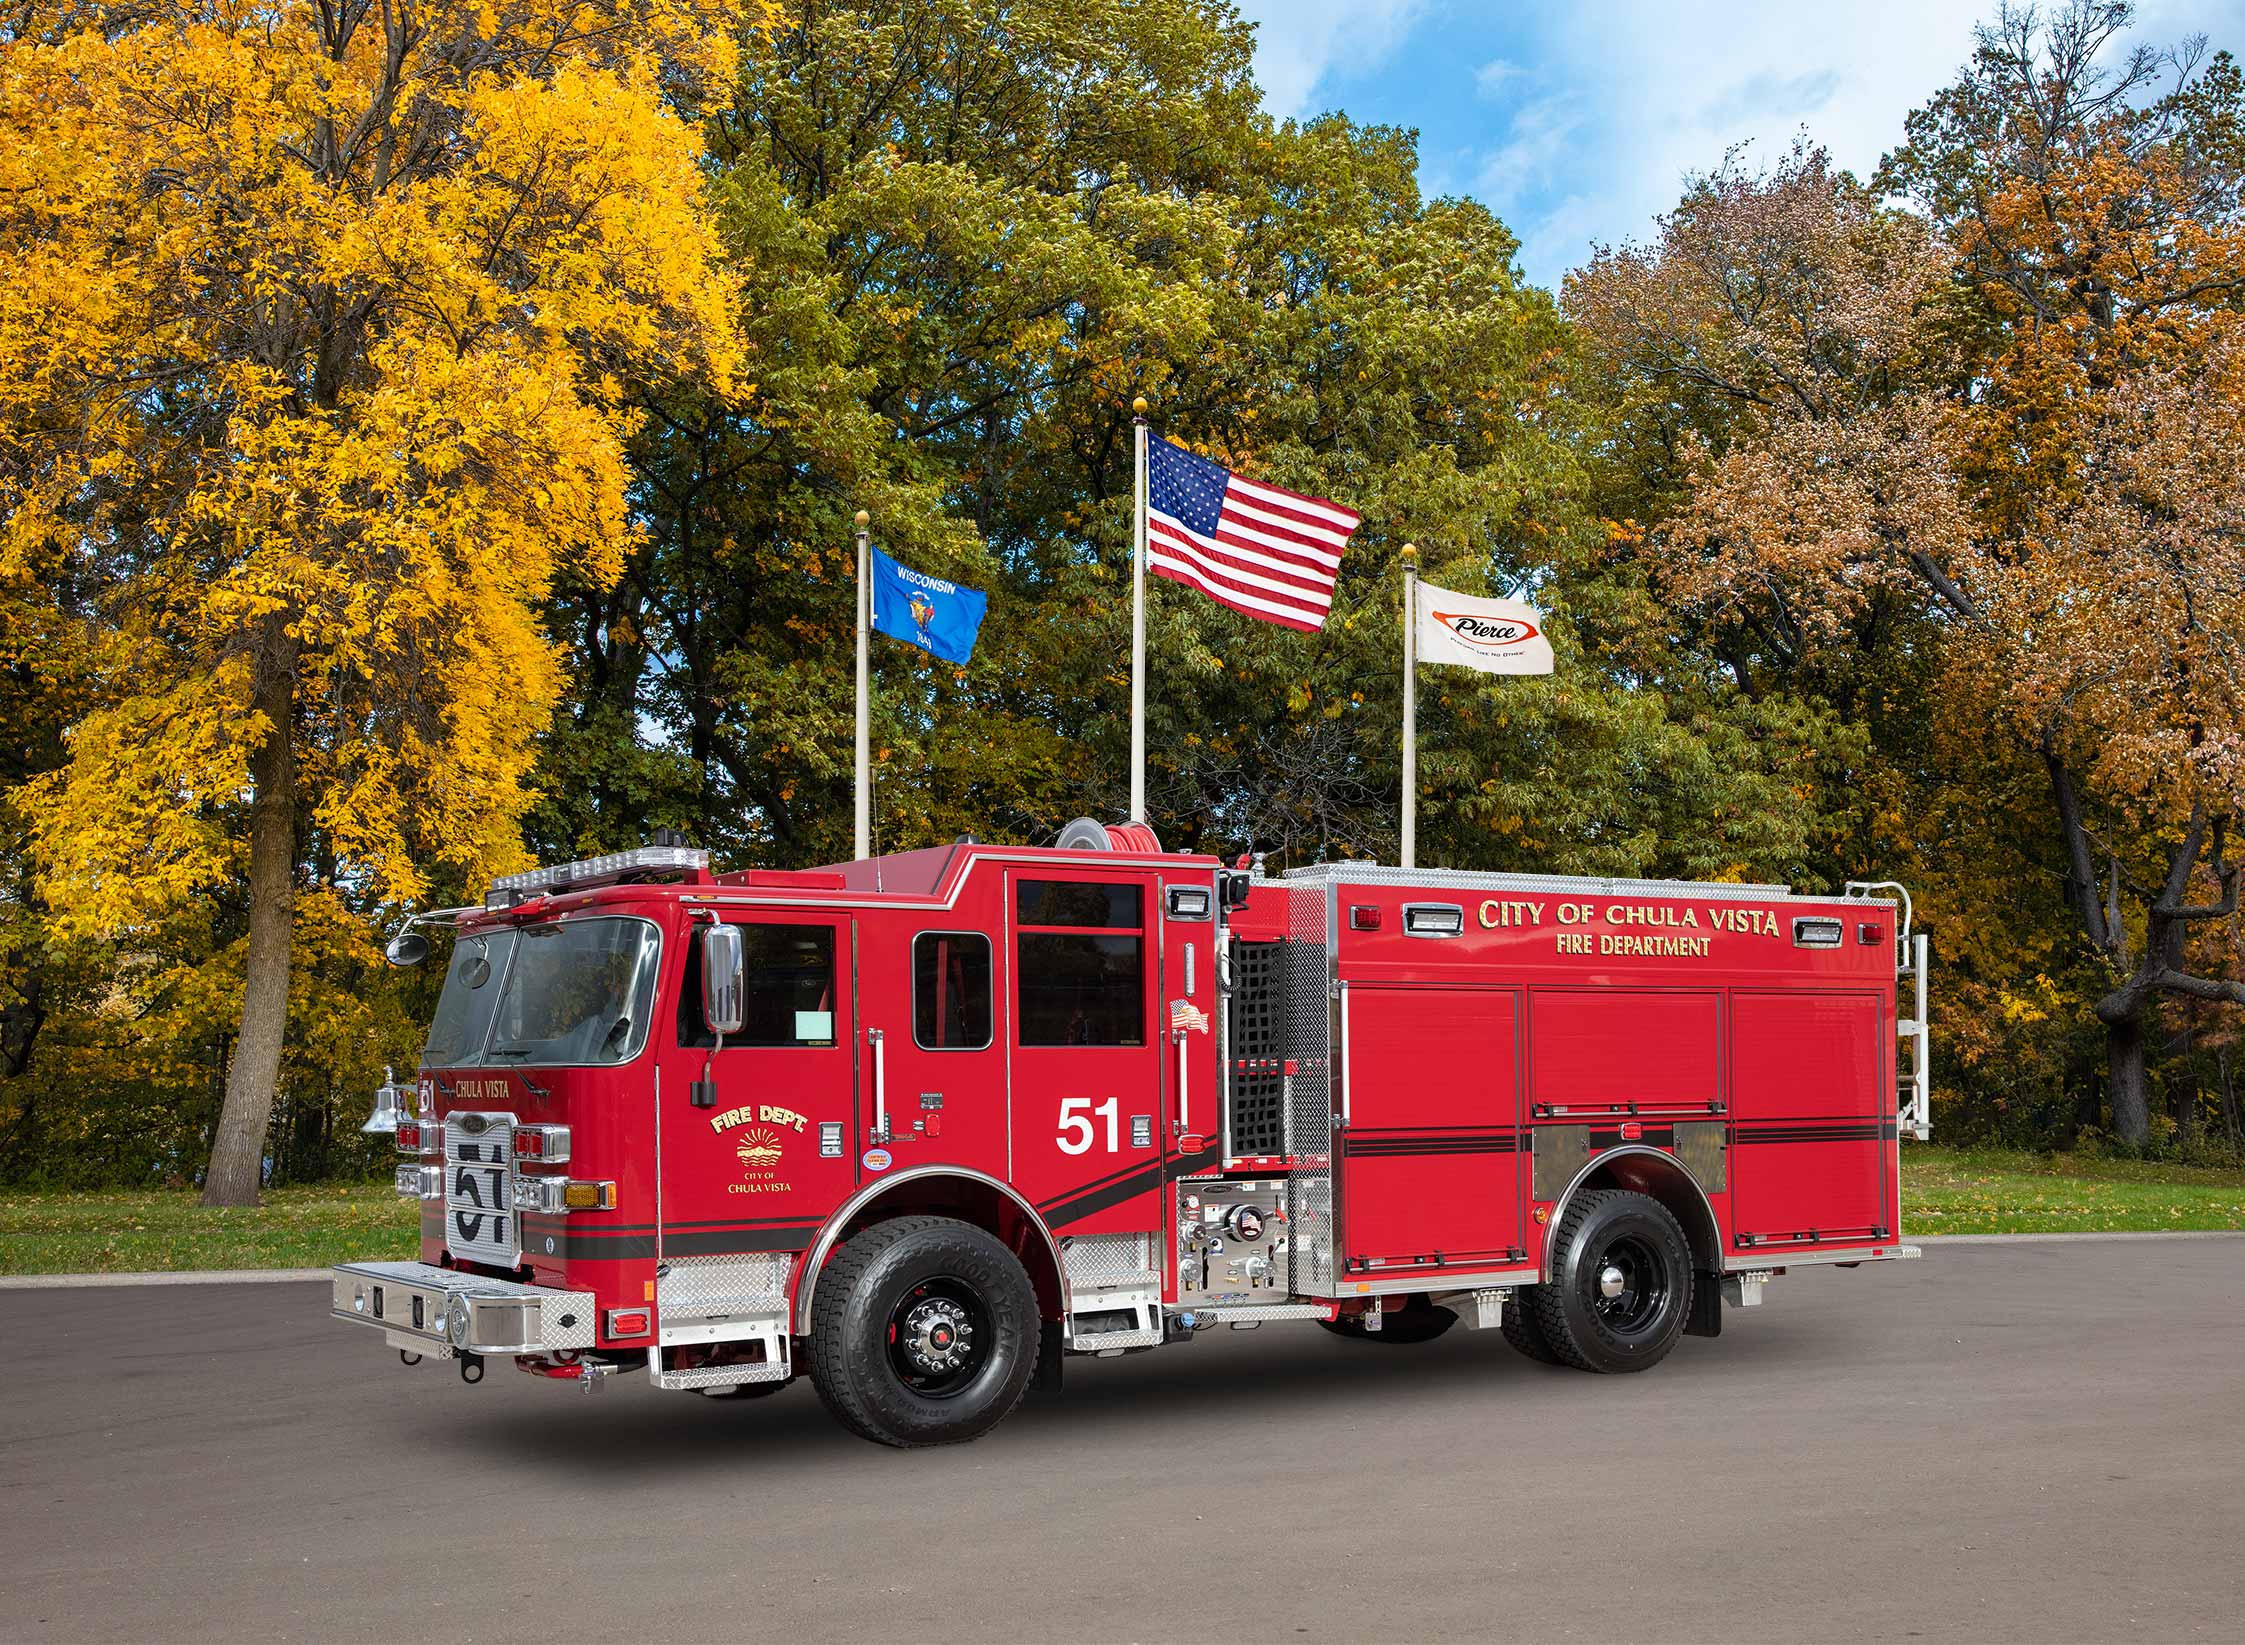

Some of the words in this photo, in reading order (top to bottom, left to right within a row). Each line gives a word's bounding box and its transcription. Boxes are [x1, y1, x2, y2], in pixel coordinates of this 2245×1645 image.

[897, 566, 956, 595] WISCONSIN
[1455, 617, 1517, 638] Pierce
[1478, 899, 1545, 929] CITY
[1556, 903, 1595, 925] OF
[1605, 904, 1699, 928] CHULA
[1708, 908, 1780, 938] VISTA
[1556, 933, 1593, 955] FIRE
[1600, 934, 1711, 957] DEPARTMENT
[455, 1080, 483, 1098] CHULA
[484, 1080, 509, 1098] VISTA
[710, 1105, 752, 1134] FIRE
[1055, 1096, 1119, 1156] 51
[728, 1183, 762, 1193] CHULA
[763, 1182, 792, 1192] VISTA
[744, 1172, 763, 1181] CITY
[764, 1172, 776, 1180] OF
[456, 1144, 508, 1243] 51
